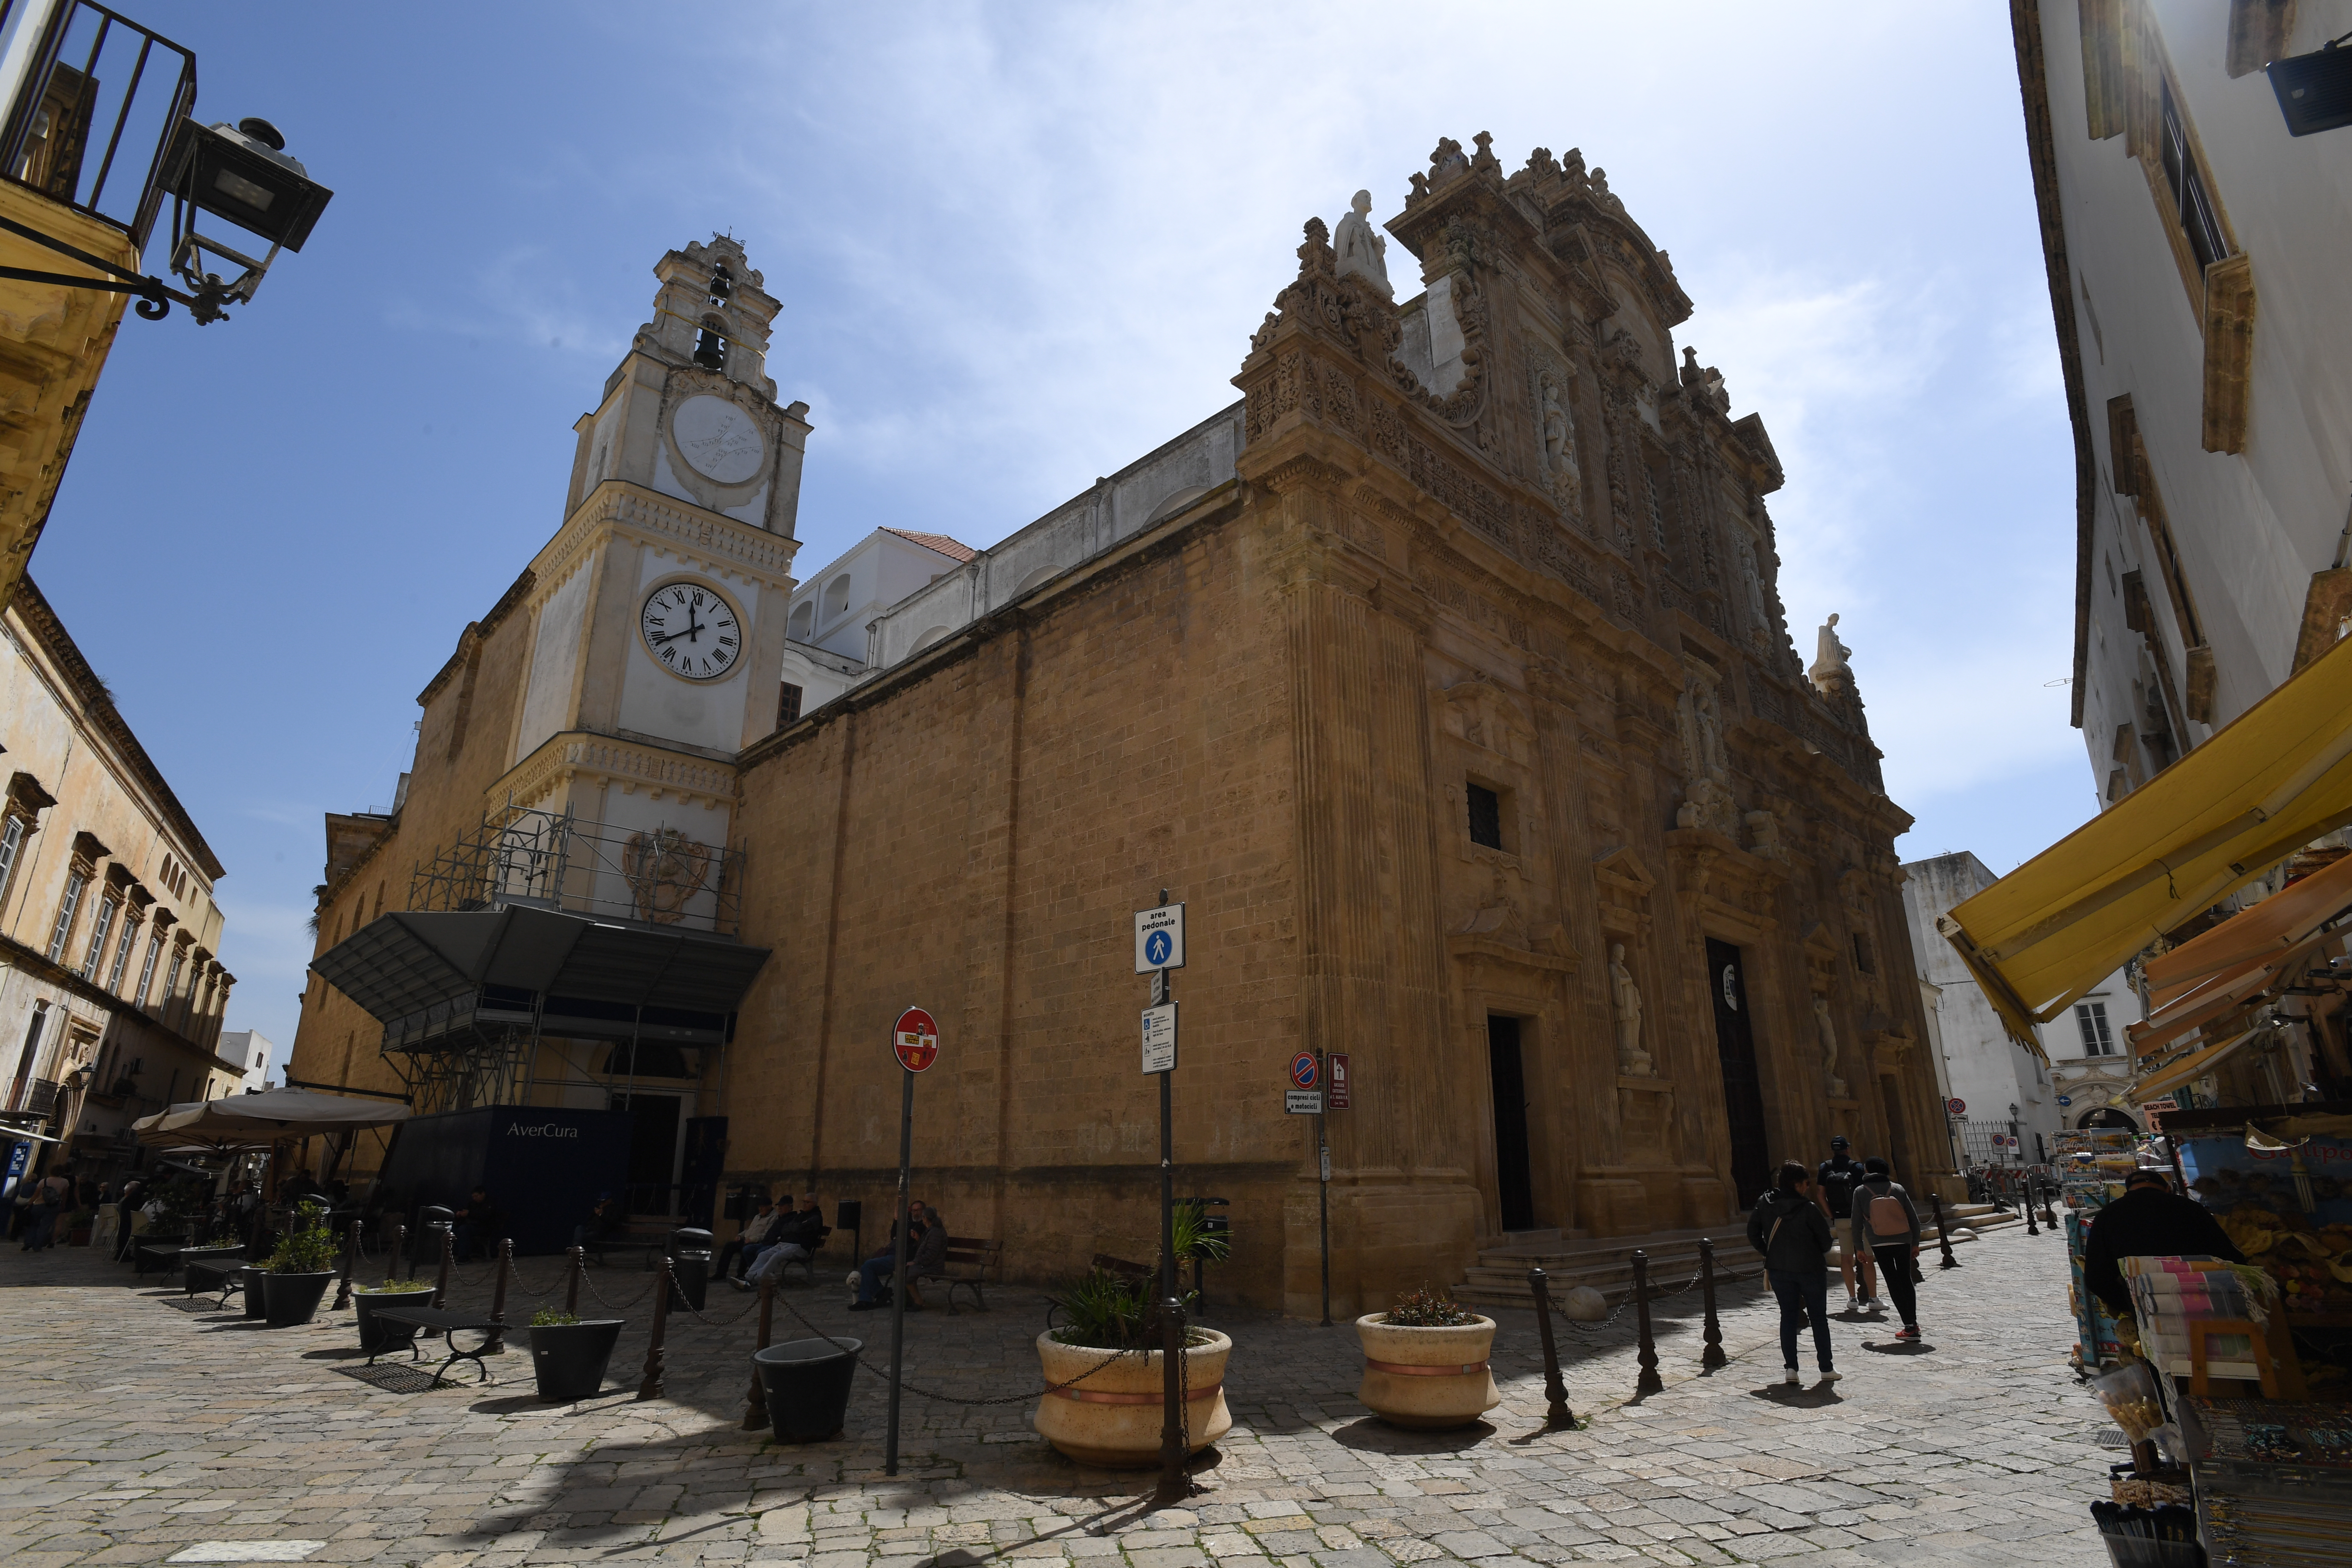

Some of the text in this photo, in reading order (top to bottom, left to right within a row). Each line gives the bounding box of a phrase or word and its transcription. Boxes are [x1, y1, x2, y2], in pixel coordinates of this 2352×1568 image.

[672, 590, 686, 605] XI
[692, 591, 704, 607] XII
[657, 598, 672, 612] X
[709, 603, 718, 613] I
[649, 614, 664, 626] IX
[719, 636, 734, 647] III
[662, 646, 677, 662] VII
[712, 648, 728, 664] IIII
[682, 656, 691, 671] VI
[702, 657, 711, 672] V
[1150, 910, 1166, 920] area
[1141, 918, 1175, 932] pedonale
[507, 1122, 577, 1138] AverCura
[2152, 1121, 2157, 1130] €
